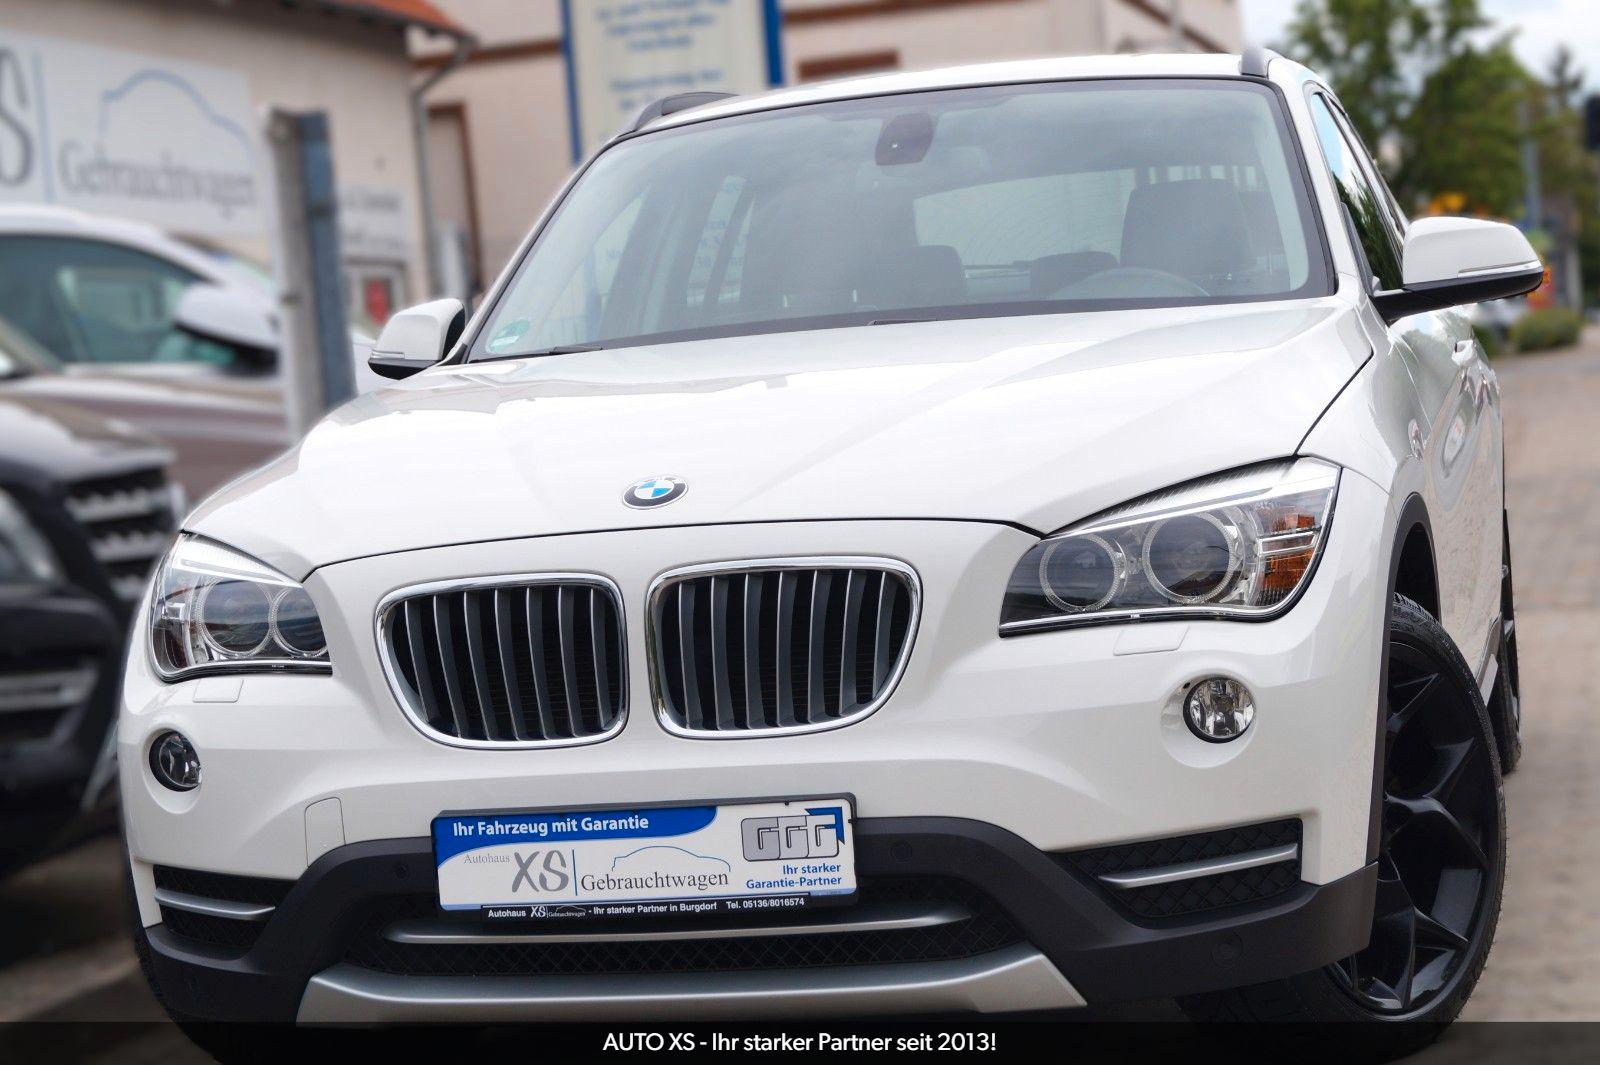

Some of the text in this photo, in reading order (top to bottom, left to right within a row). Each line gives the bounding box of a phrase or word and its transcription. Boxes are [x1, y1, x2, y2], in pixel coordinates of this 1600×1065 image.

[453, 815, 649, 837] Ihr Fahrzeug mit Garantie
[464, 850, 728, 893] Autohaus XS Gebrauchtwagen
[783, 863, 841, 875] Ihr starker
[746, 875, 842, 889] Garantie-Partner
[488, 909, 526, 918] Autohaus
[530, 905, 546, 918] XS
[593, 906, 604, 915] Ihr
[606, 905, 635, 914] starker
[637, 904, 667, 913] Partner
[670, 903, 678, 912] in
[680, 901, 717, 912] Burgdorf
[726, 900, 740, 909] Tel.
[743, 897, 805, 908] 05136/8016574
